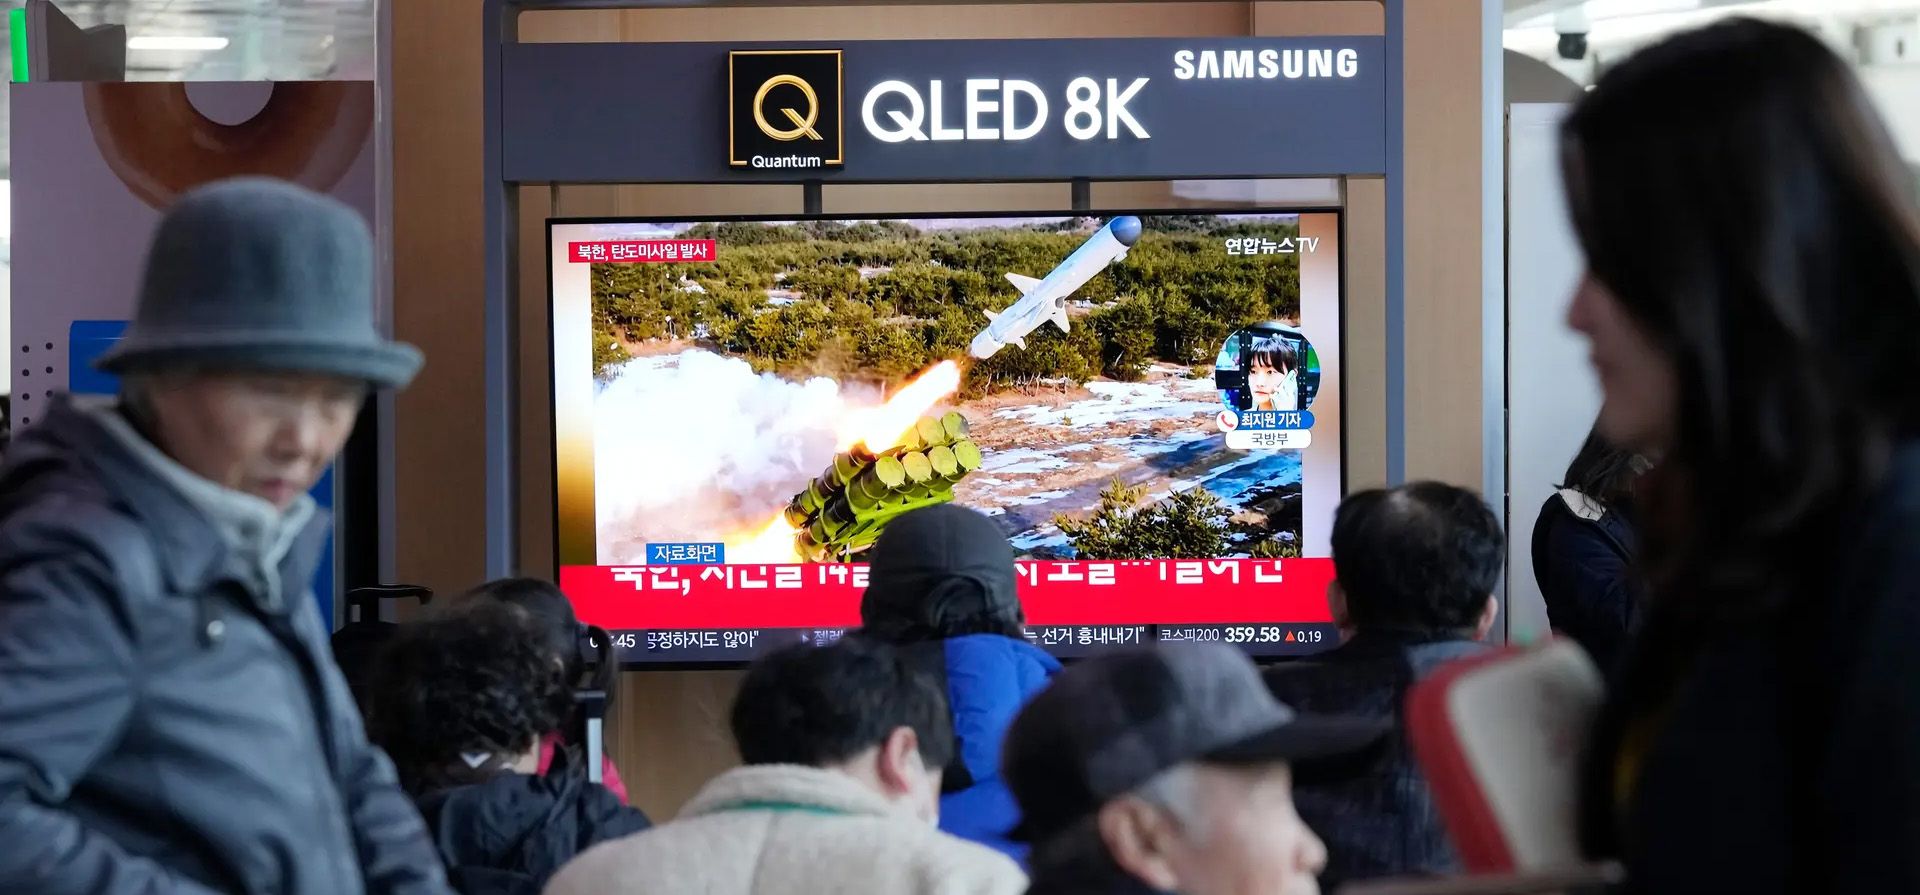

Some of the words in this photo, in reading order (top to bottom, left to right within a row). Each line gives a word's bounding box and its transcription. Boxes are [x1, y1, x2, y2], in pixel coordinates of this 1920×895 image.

[1173, 48, 1359, 80] SAMSUNG
[753, 74, 824, 141] Q
[861, 79, 1050, 143] QLED
[1063, 76, 1152, 141] 8K
[752, 154, 821, 168] Quantum
[577, 244, 609, 262] 북한,
[611, 243, 678, 260] 탄도미사일
[680, 243, 708, 259] 발사
[1225, 237, 1320, 255] 연합뉴스TV
[1241, 412, 1276, 428] 최지원
[1278, 412, 1301, 428] 기자
[1251, 432, 1289, 446] 국방부
[654, 544, 717, 563] 자료화면
[1041, 627, 1073, 645] 선거
[1160, 628, 1220, 643] 코스피200
[1224, 626, 1280, 643] 359.58
[1297, 630, 1322, 643] 0.19
